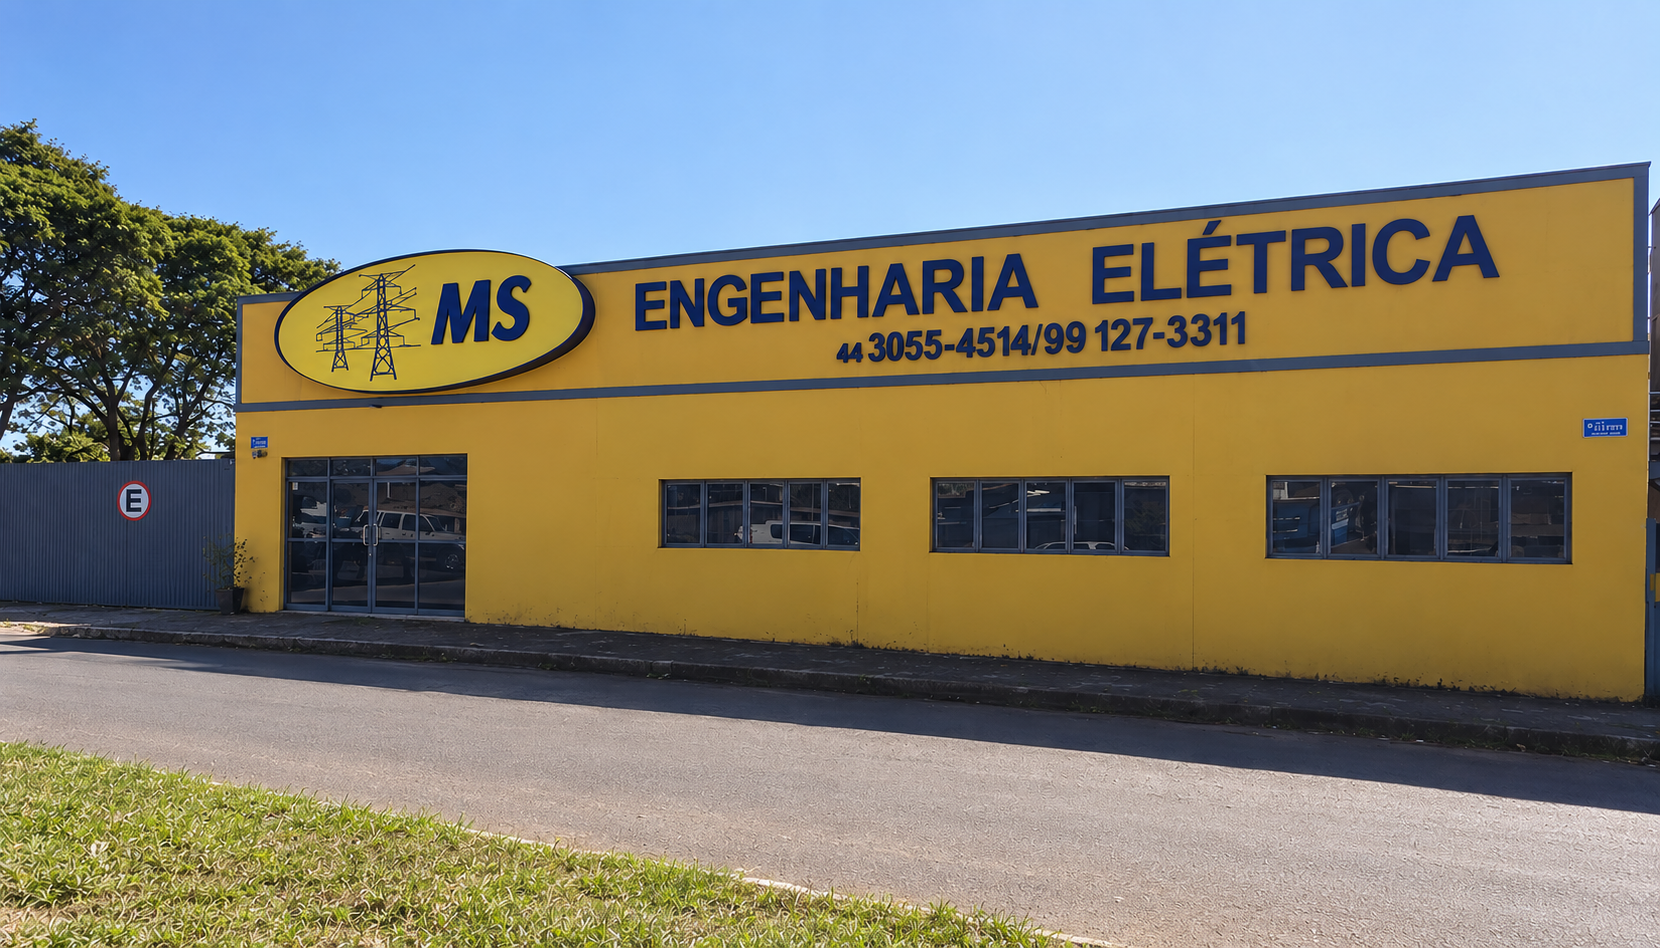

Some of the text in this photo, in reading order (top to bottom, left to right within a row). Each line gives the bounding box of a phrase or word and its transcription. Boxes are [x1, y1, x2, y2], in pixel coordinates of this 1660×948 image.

[635, 215, 1500, 331] ENGENHARIA ELÉTRICA
[431, 275, 532, 345] MS
[836, 342, 863, 363] 44
[1094, 311, 1246, 352] 127-3311
[126, 489, 142, 512] E
